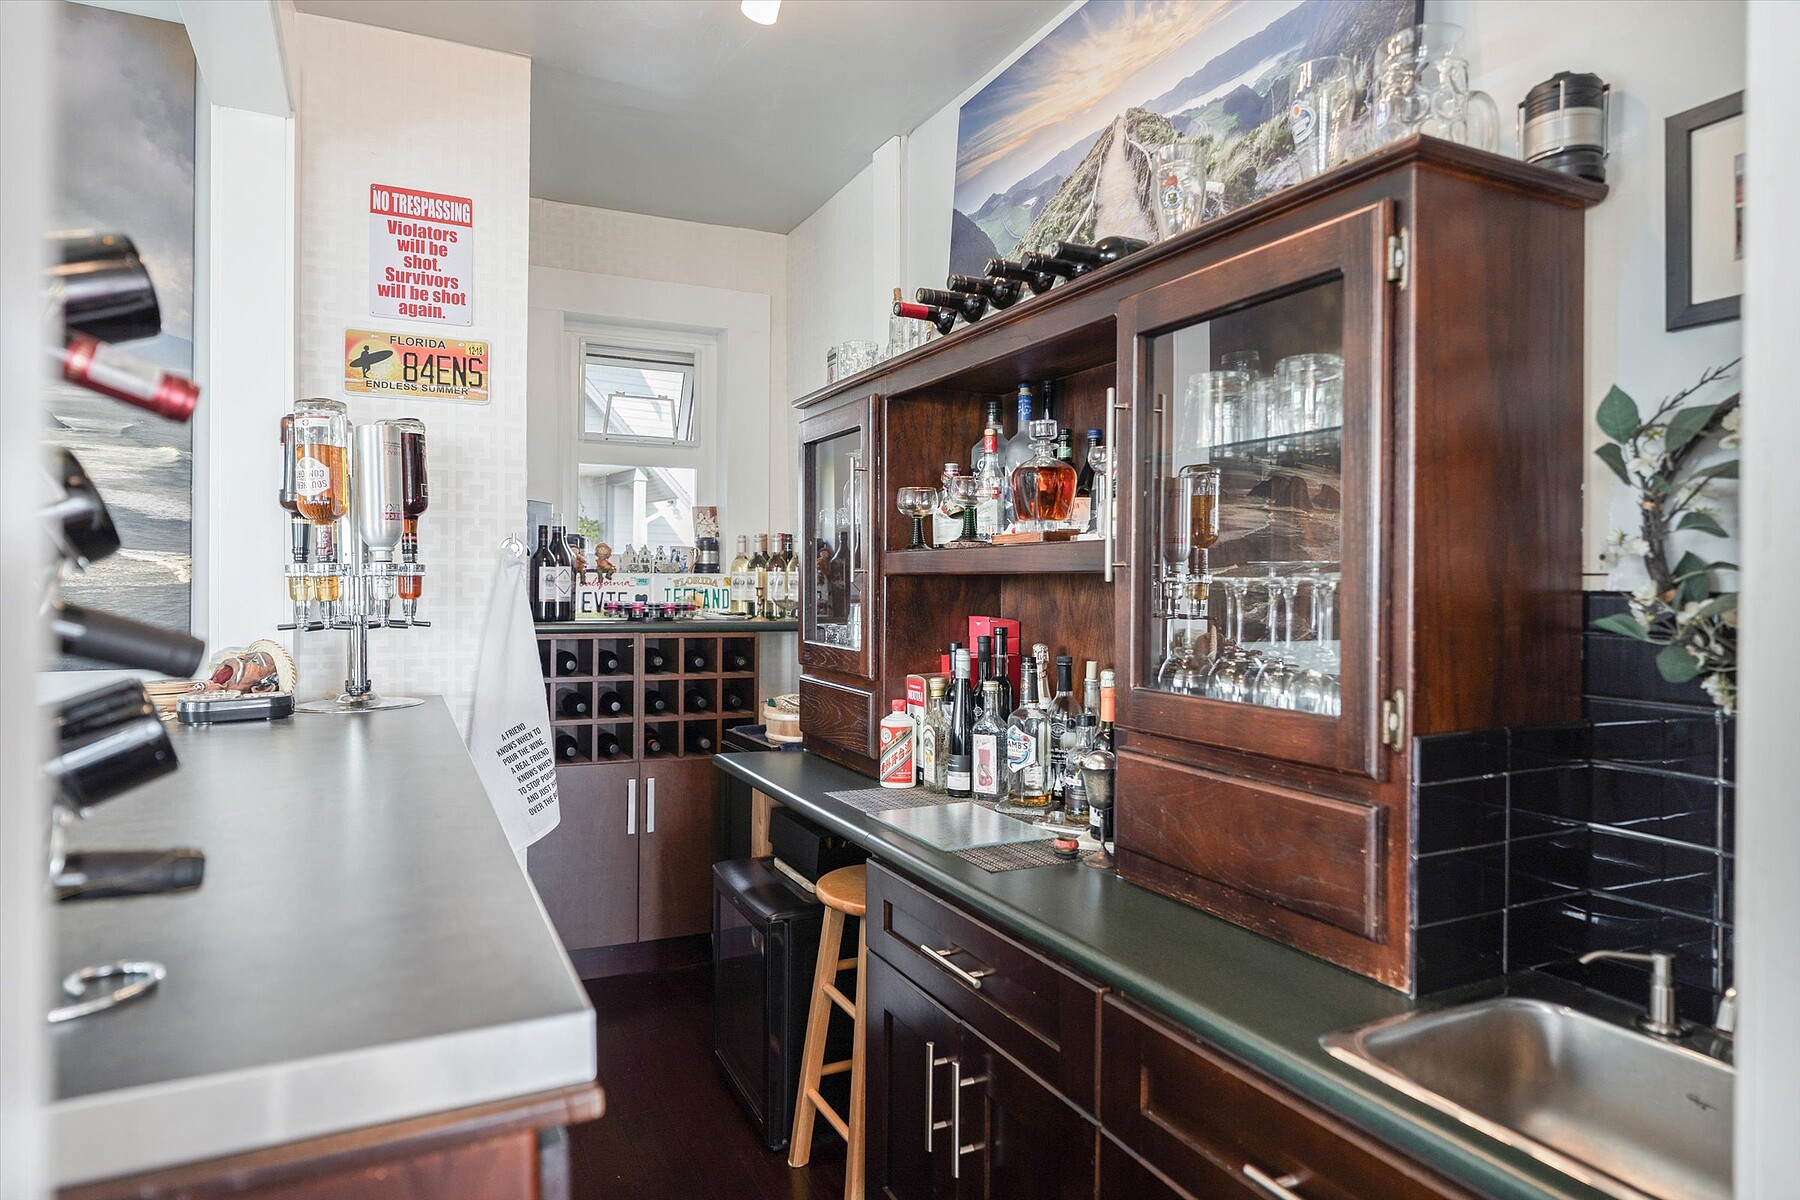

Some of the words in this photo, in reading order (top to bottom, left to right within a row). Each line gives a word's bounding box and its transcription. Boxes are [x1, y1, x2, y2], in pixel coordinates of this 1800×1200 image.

[373, 190, 390, 211] NO
[392, 192, 470, 223] TRESPASSING
[387, 220, 458, 243] Violators
[397, 239, 425, 254] will
[429, 241, 448, 257] be
[404, 255, 441, 272] shot.
[385, 267, 458, 289] Survivors
[377, 283, 406, 299] will
[410, 286, 428, 301] be
[432, 290, 466, 306] shot
[399, 302, 446, 319] again.
[390, 336, 446, 349] FLORIDA
[403, 352, 482, 388] 84ENS
[366, 380, 418, 391] ENDLESS
[421, 384, 469, 395] SUMMER
[505, 722, 526, 738] FRIEND
[496, 740, 517, 757] KNOWS
[516, 732, 534, 745] WHEN
[532, 727, 542, 736] TO
[502, 752, 519, 766] POUR
[518, 745, 530, 757] THE
[528, 738, 546, 751] WINE.
[1008, 740, 1028, 750] AMB'S
[511, 767, 516, 775] A
[515, 759, 531, 772] REAL
[529, 747, 550, 763] FRIEND
[517, 767, 538, 784] KNOWS
[536, 758, 553, 772] WHEN
[518, 786, 527, 796] TO
[527, 778, 541, 791] STOP
[527, 792, 538, 804] AND
[539, 784, 552, 798] JUST
[528, 802, 543, 816] OVER
[542, 795, 555, 807] THE
